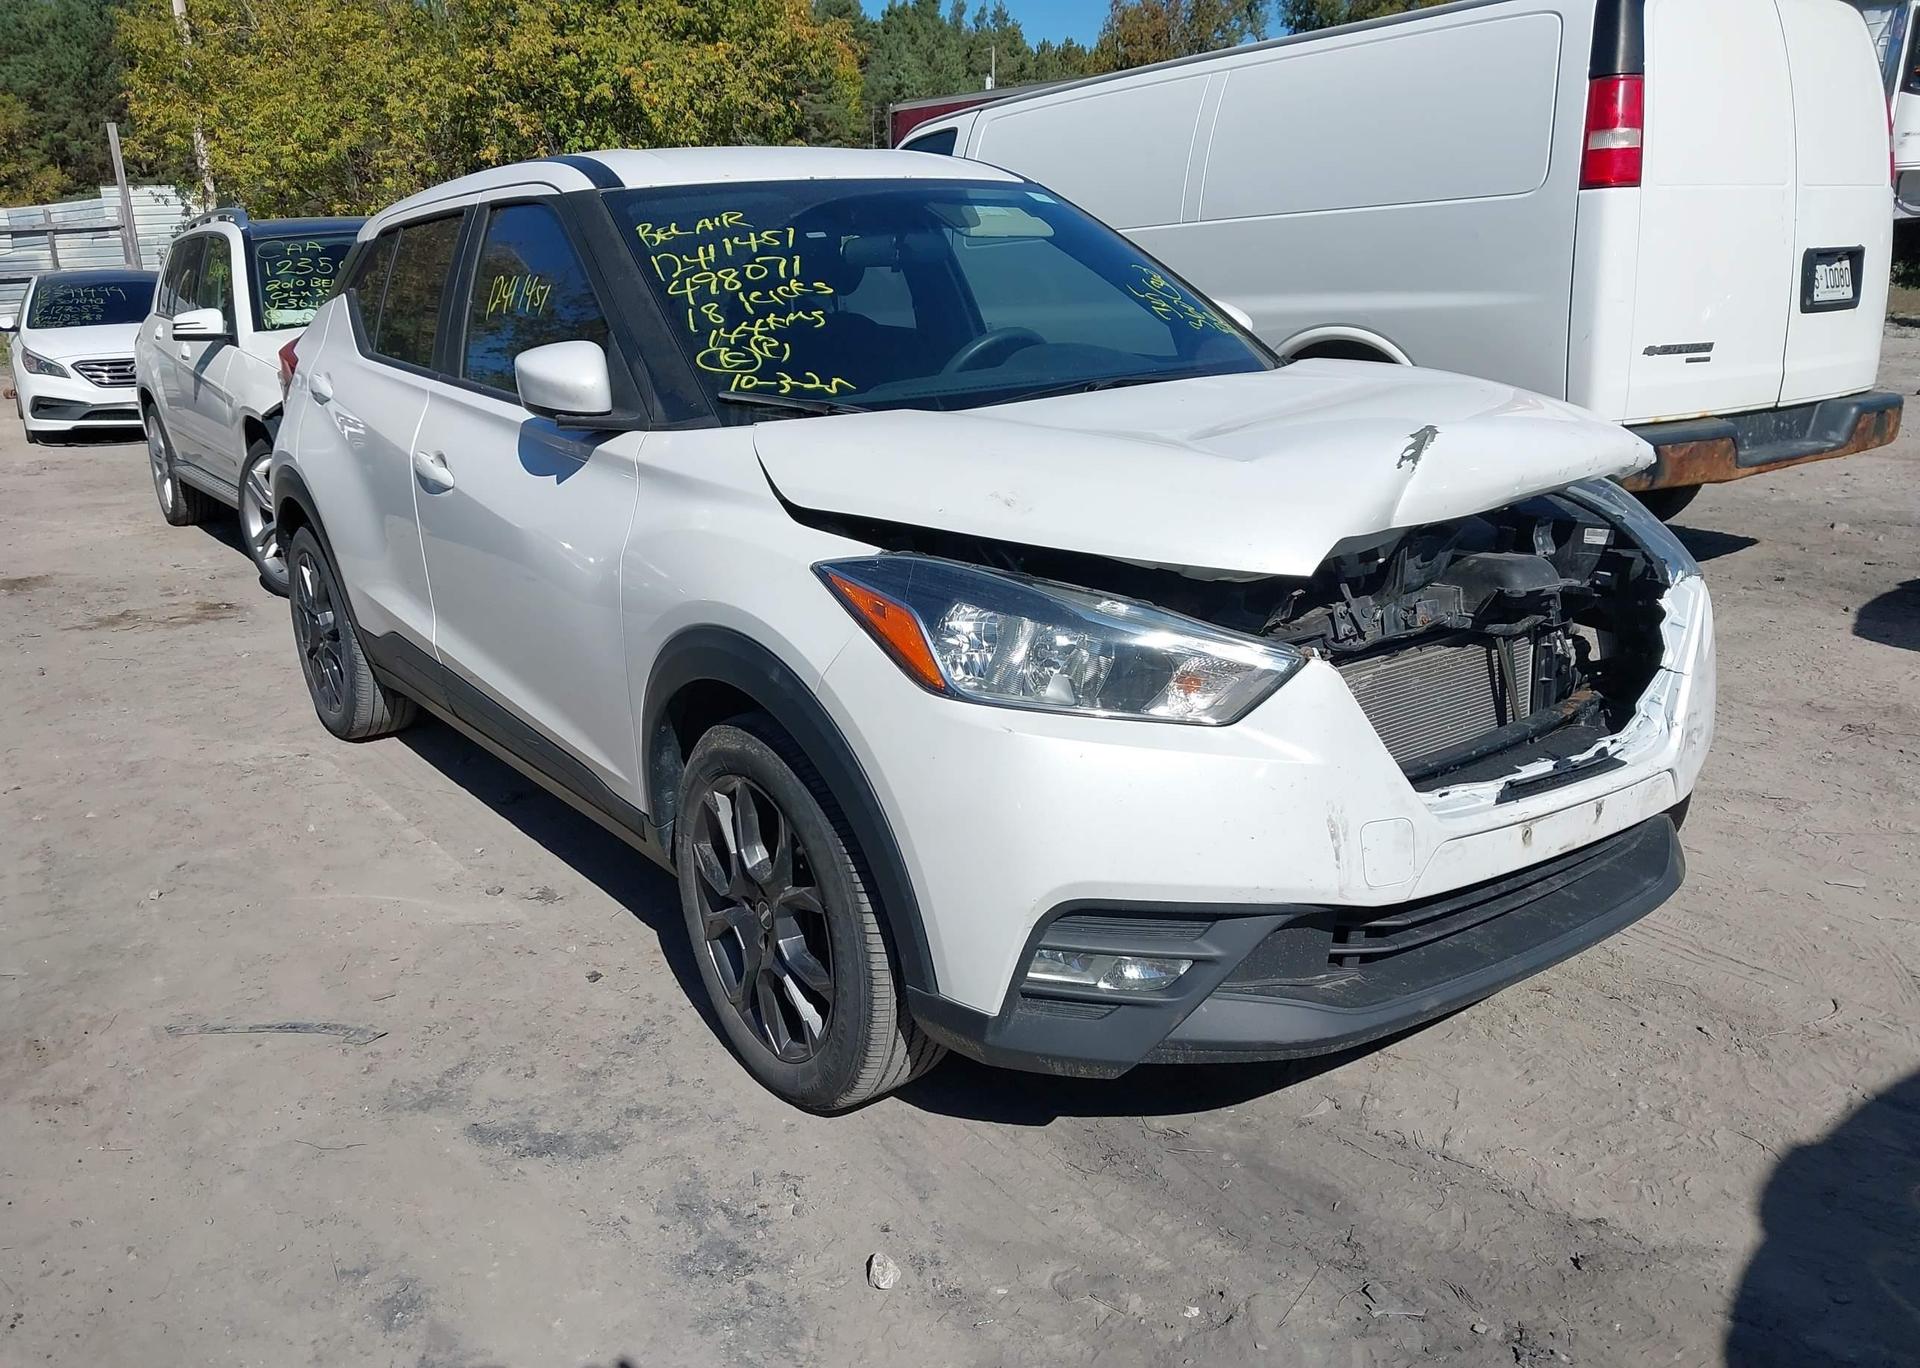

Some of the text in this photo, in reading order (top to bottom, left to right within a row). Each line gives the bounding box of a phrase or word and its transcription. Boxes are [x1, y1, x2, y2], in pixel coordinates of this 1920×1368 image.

[695, 211, 754, 236] AIR
[265, 278, 306, 292] 2010
[687, 303, 725, 333] 18
